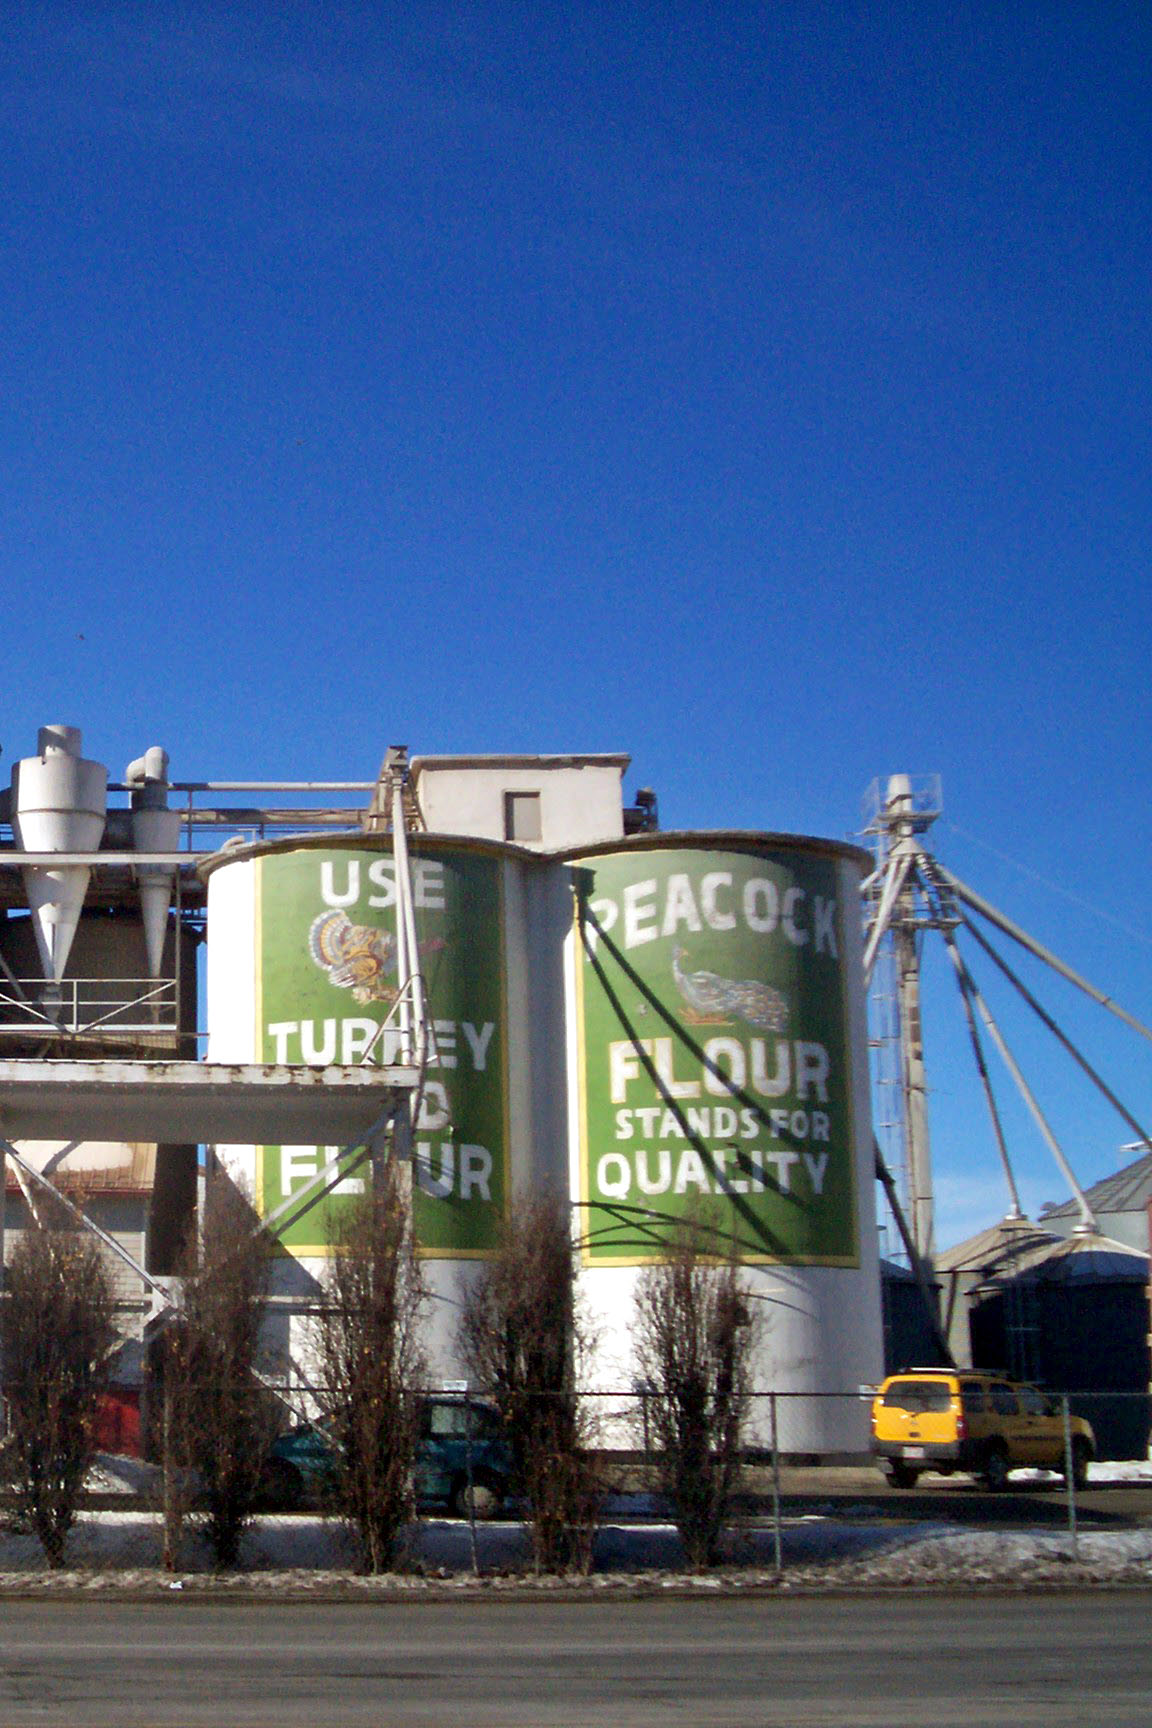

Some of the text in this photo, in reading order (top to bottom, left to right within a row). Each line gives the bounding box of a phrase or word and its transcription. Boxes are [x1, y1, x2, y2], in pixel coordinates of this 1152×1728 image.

[321, 859, 446, 908] USE
[585, 872, 838, 960] PEACOCK
[608, 1036, 830, 1103] FLOUR
[615, 1107, 830, 1141] STANDS FOR
[281, 1142, 493, 1200] FLUR
[597, 1151, 828, 1200] QUALITY
